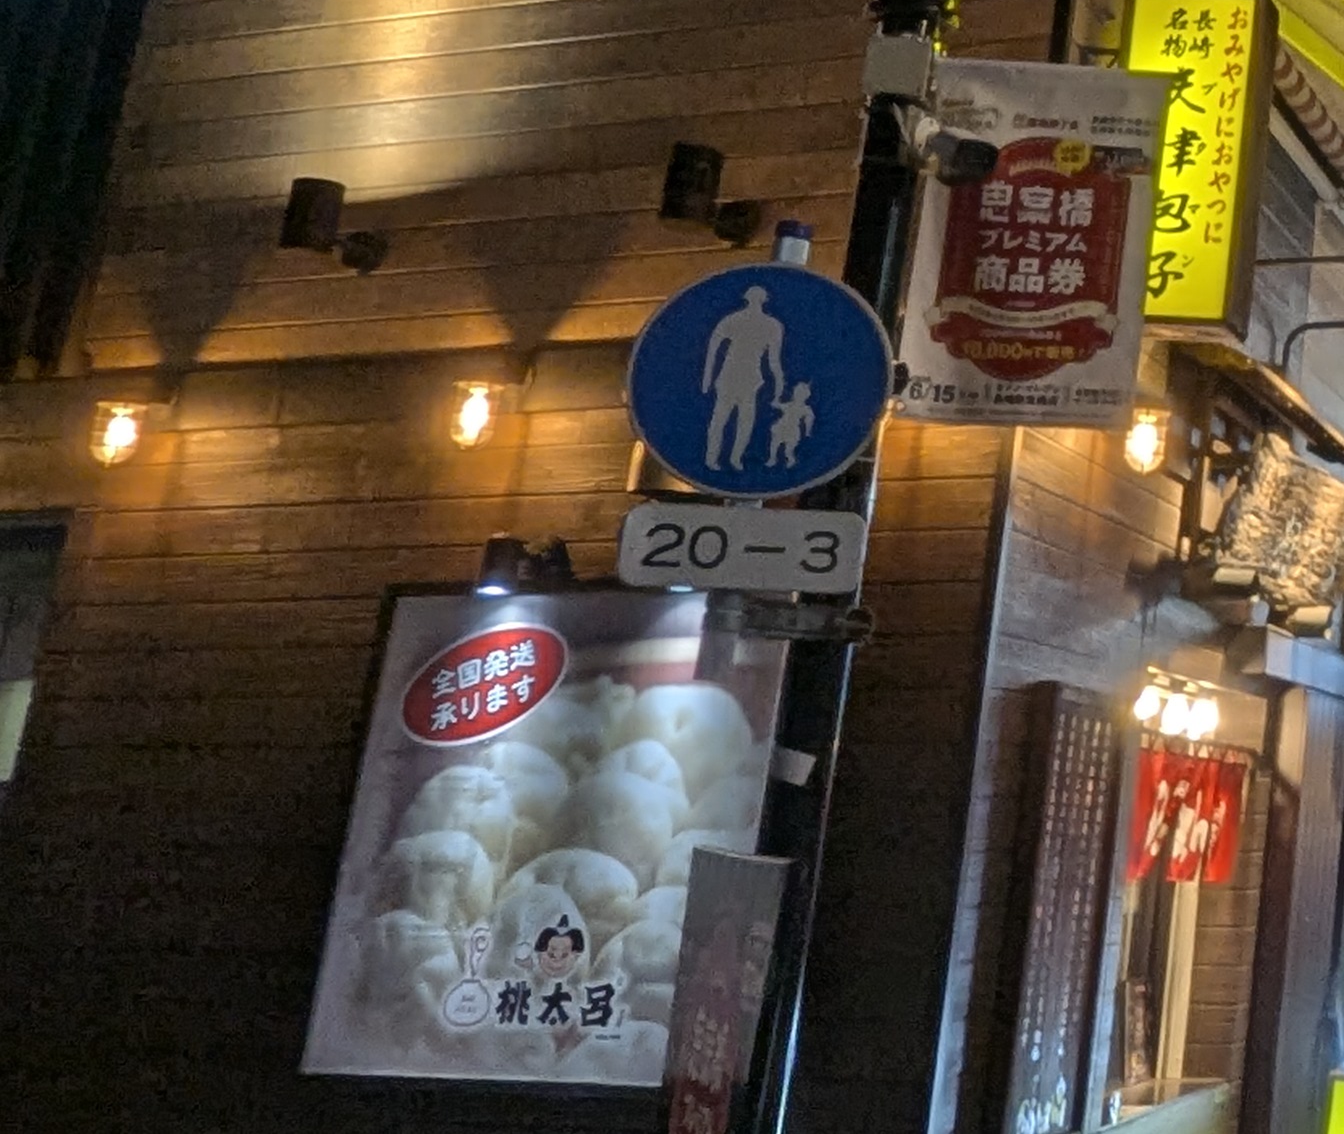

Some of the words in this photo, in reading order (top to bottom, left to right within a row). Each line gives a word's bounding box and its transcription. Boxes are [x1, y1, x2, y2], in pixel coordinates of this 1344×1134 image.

[1203, 6, 1248, 245] おみやげにおやつに
[979, 180, 1095, 227] 思案橋
[978, 228, 1088, 253] プレミアム
[974, 254, 1087, 295] 商品券
[641, 522, 841, 574] 20-3
[431, 639, 536, 699] 全国発送
[430, 674, 536, 732] 承ります
[495, 980, 616, 1028] 桃太呂
